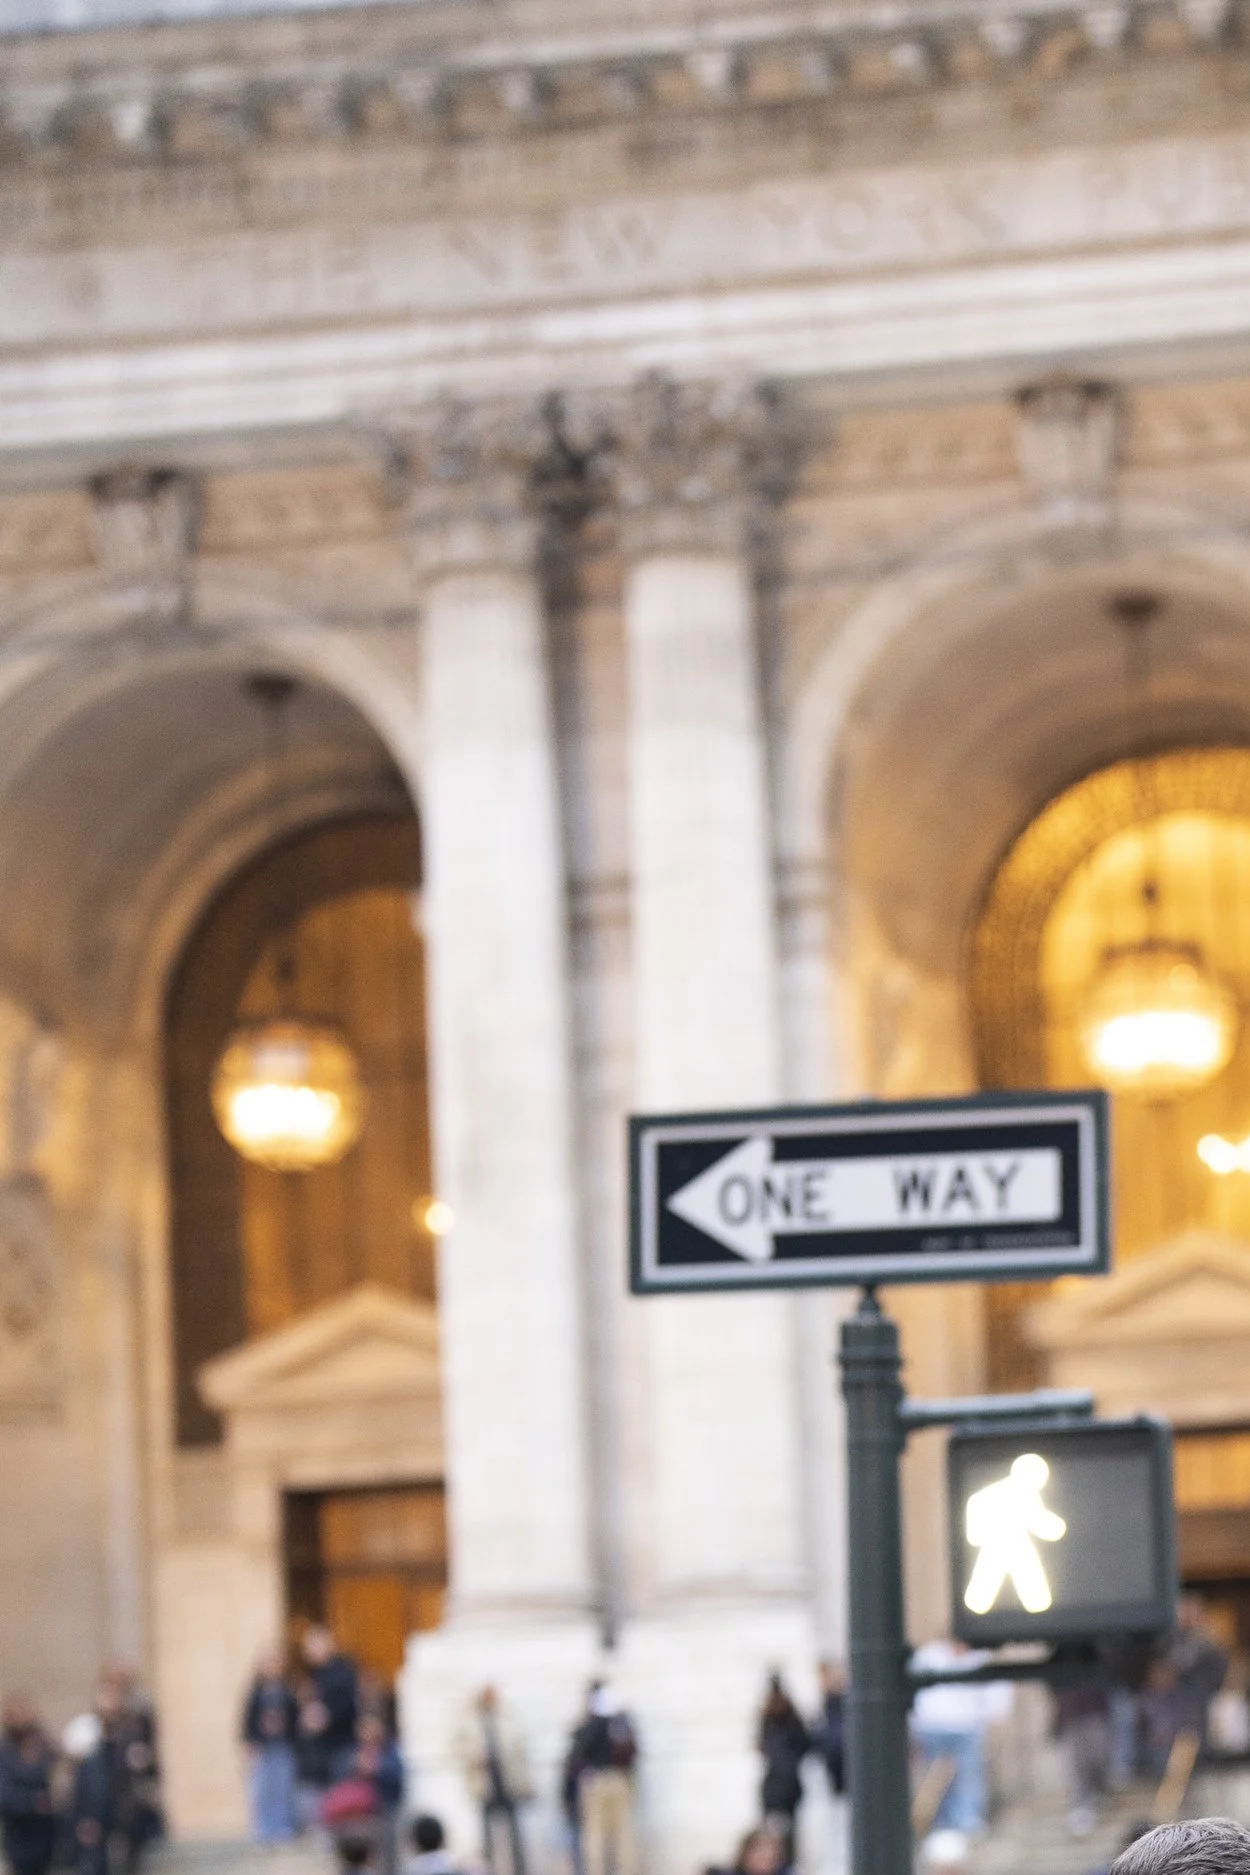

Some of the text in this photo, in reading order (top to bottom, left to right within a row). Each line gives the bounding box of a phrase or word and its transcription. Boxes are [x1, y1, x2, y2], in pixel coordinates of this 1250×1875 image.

[446, 207, 670, 286] NEW
[756, 178, 1010, 260] YORK
[718, 1157, 1023, 1227] ONE WAY
